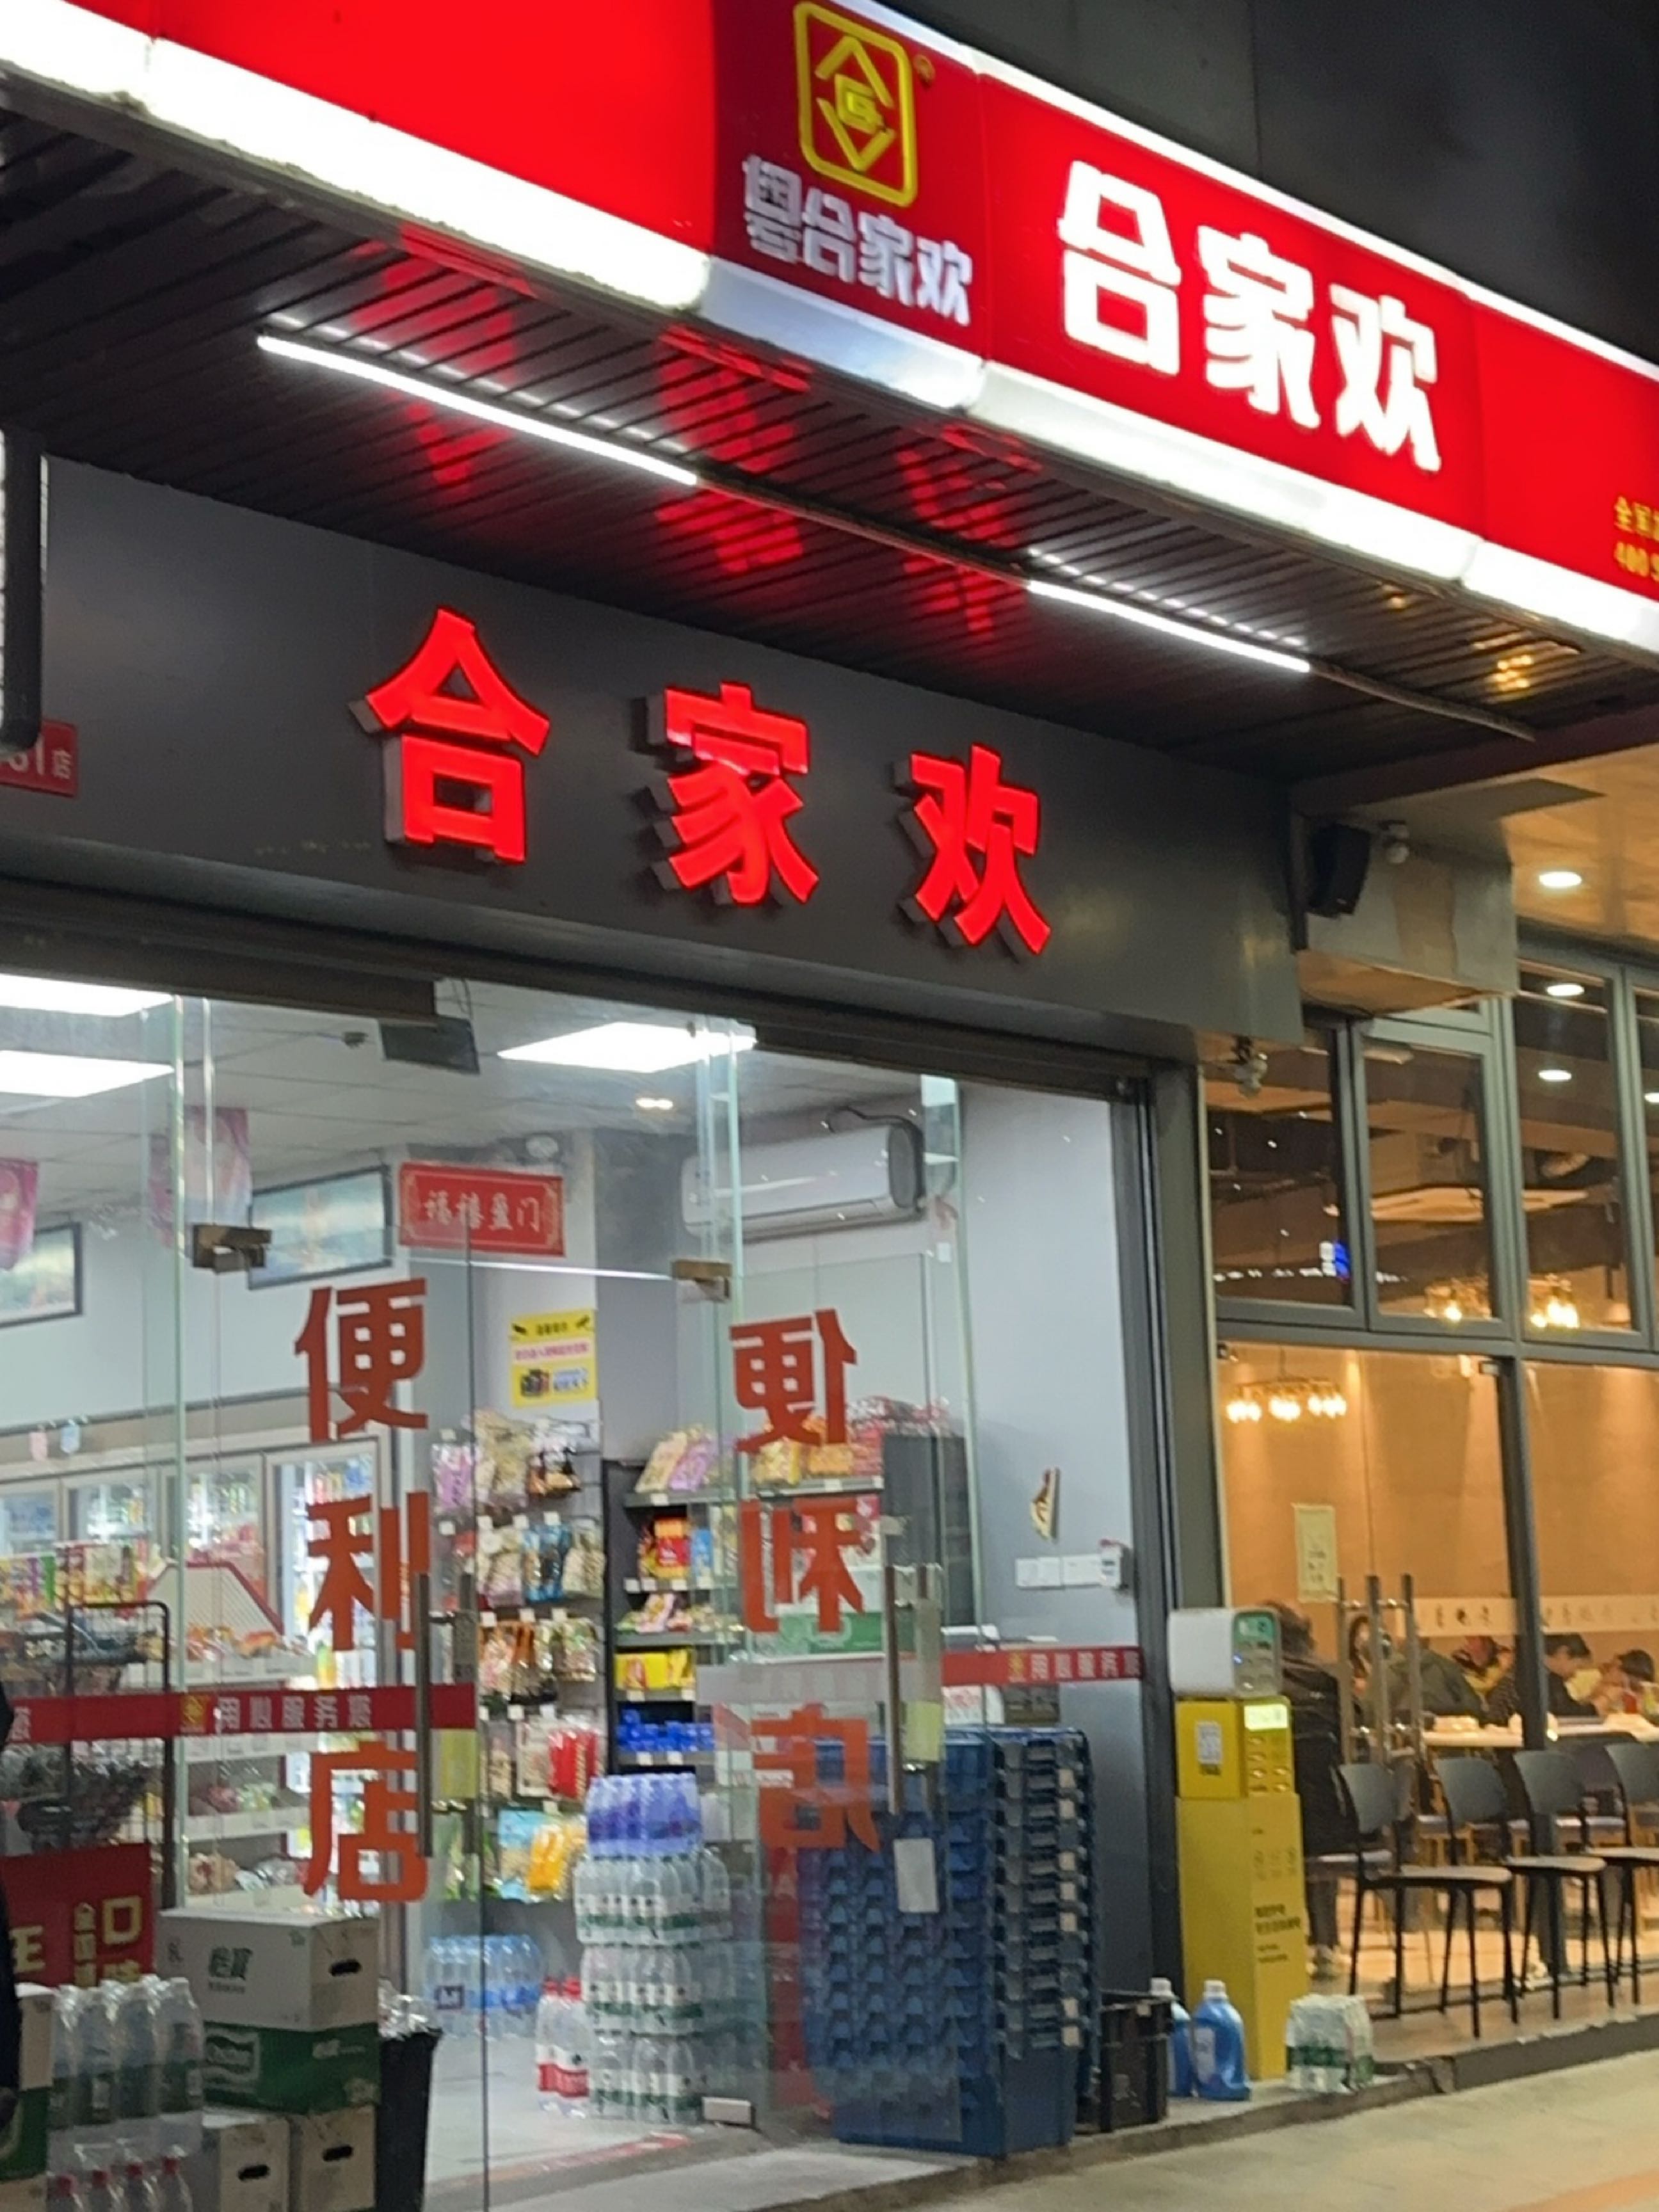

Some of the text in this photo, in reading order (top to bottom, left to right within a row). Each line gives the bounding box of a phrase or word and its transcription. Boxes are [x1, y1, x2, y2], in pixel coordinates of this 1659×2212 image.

[742, 155, 972, 327] 粤合家欢
[1057, 160, 1441, 472] 合家欢
[365, 608, 1050, 954] 合家欢
[294, 1277, 429, 1902] 便利店
